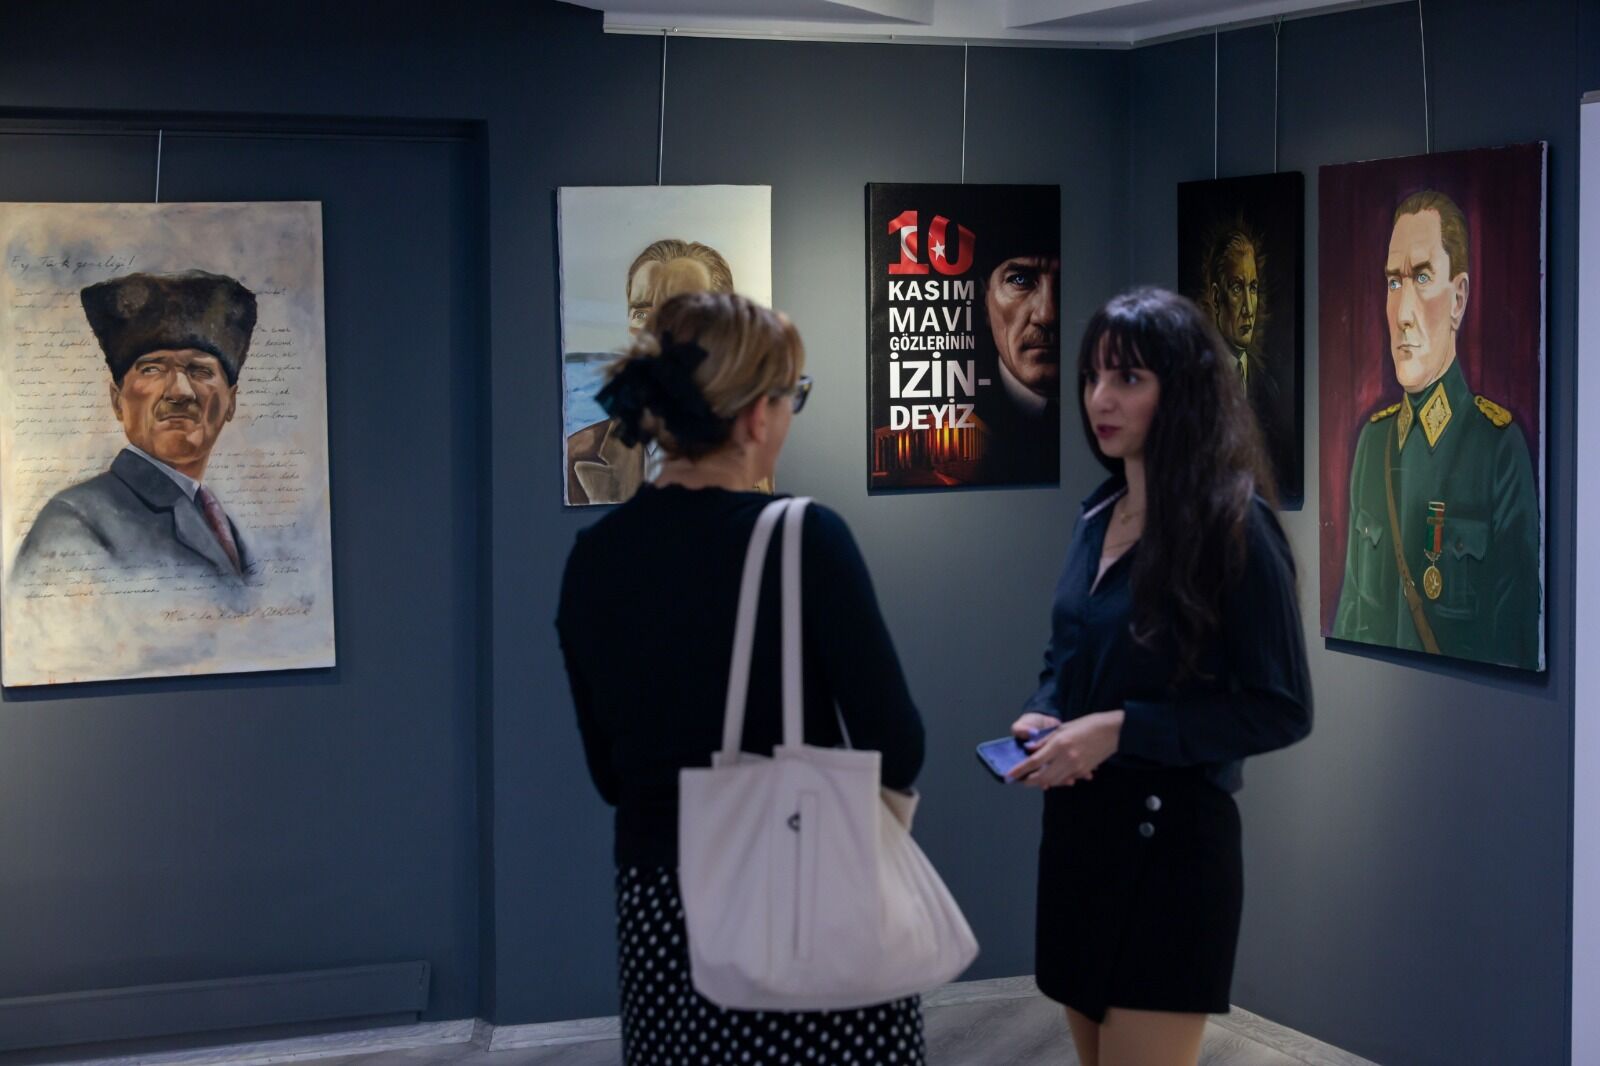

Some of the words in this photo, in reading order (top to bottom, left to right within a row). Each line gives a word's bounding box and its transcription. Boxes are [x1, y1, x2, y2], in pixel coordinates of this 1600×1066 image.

[888, 210, 976, 275] 10
[888, 280, 975, 301] KASIM
[888, 300, 972, 333] MAVİ
[889, 333, 975, 351] GÖZLERİNİN
[889, 351, 991, 399] İZİN-
[889, 398, 976, 431] DEYİZ
